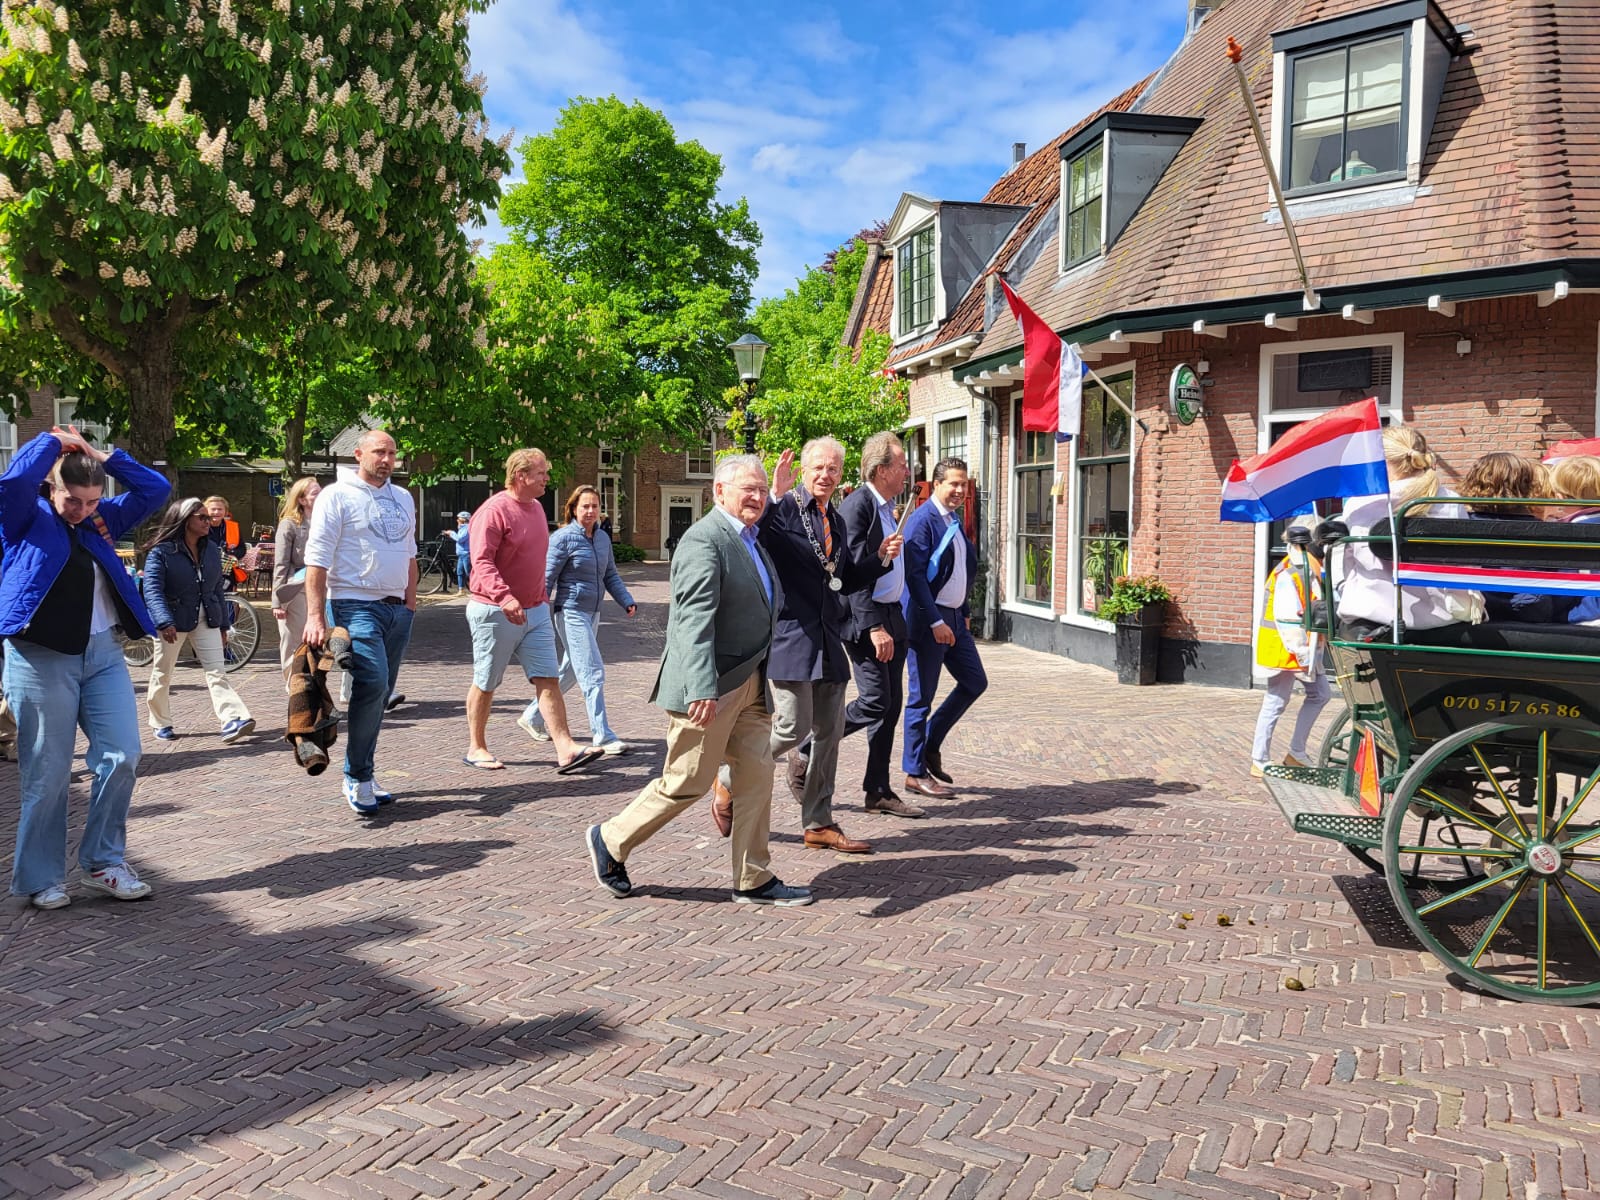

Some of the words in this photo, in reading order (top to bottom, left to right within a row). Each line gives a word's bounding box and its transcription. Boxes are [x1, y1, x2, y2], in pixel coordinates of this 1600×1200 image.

[1181, 388, 1199, 397] Hein
[272, 480, 280, 489] P
[1443, 695, 1479, 710] 070
[1485, 699, 1520, 713] 517
[1526, 702, 1550, 715] 65
[1556, 705, 1581, 718] 86
